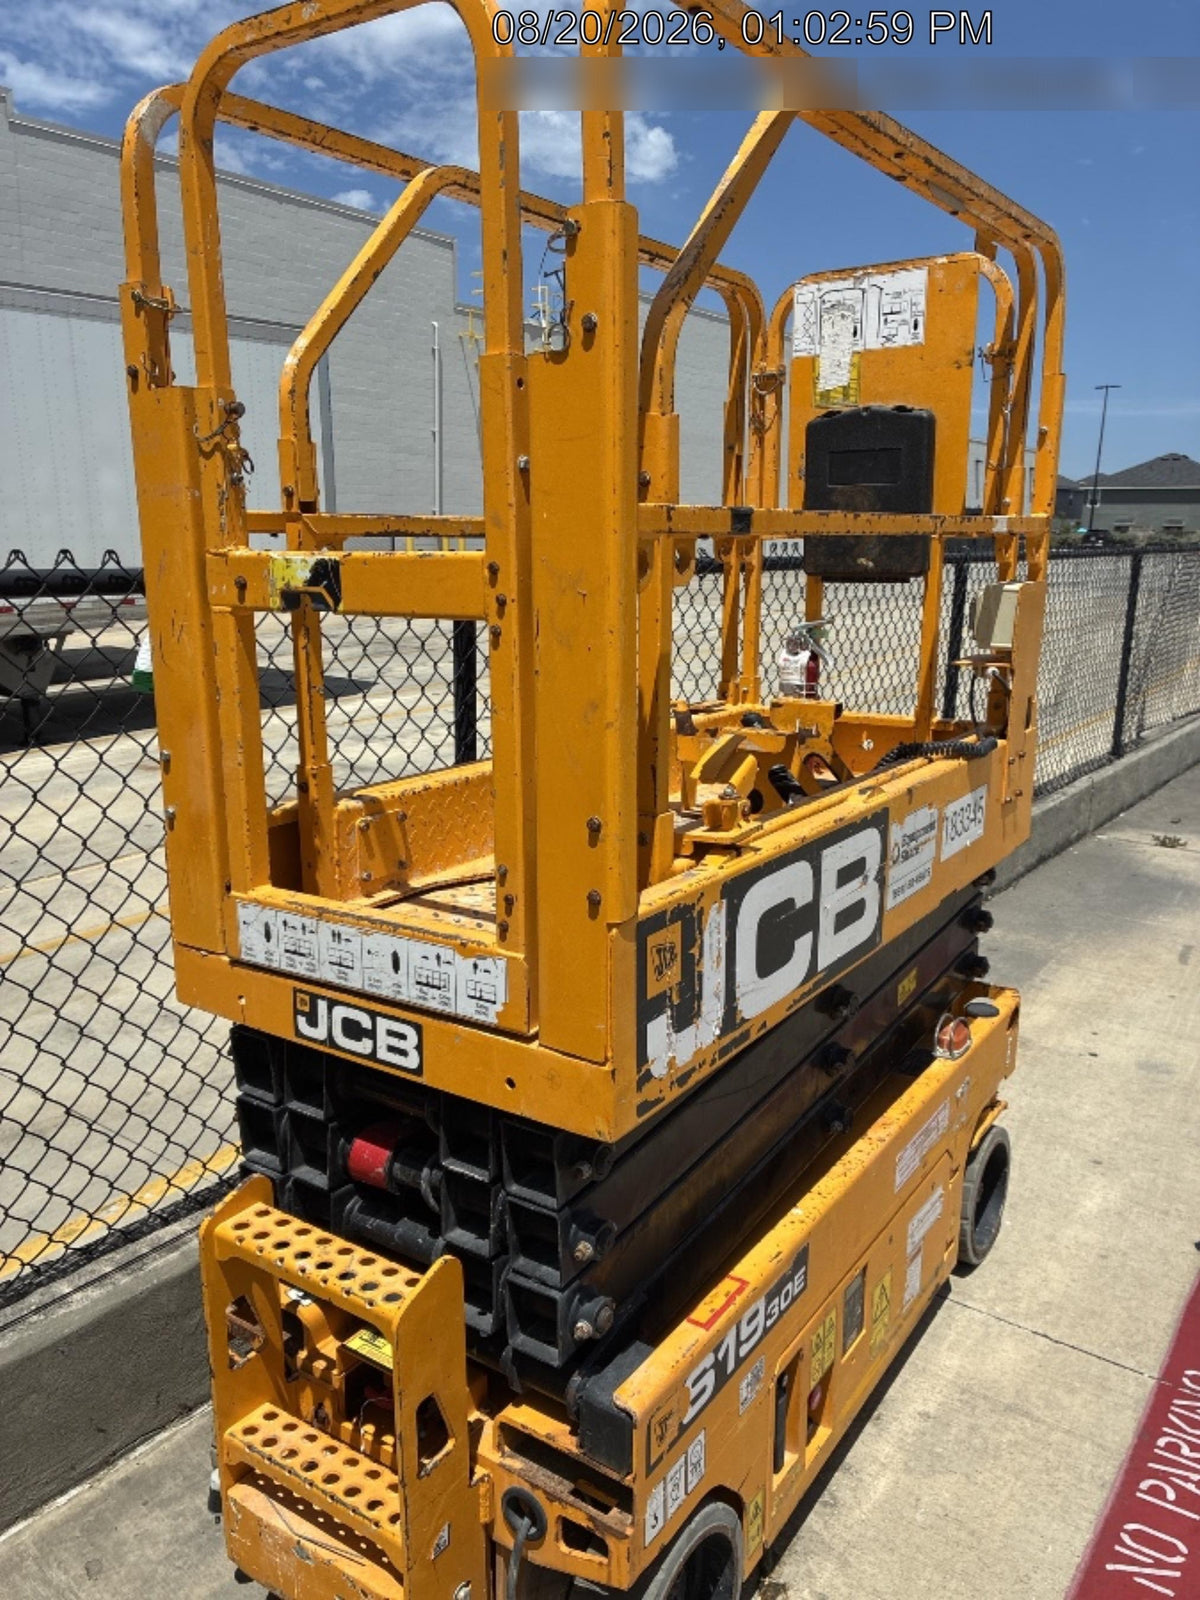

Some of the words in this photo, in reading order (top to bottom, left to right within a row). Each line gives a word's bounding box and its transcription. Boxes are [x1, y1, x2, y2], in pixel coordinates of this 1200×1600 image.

[647, 827, 882, 1079] JCB
[296, 999, 421, 1070] JCB
[1135, 1370, 1200, 1521] PARK
[1105, 1522, 1189, 1598] NO
